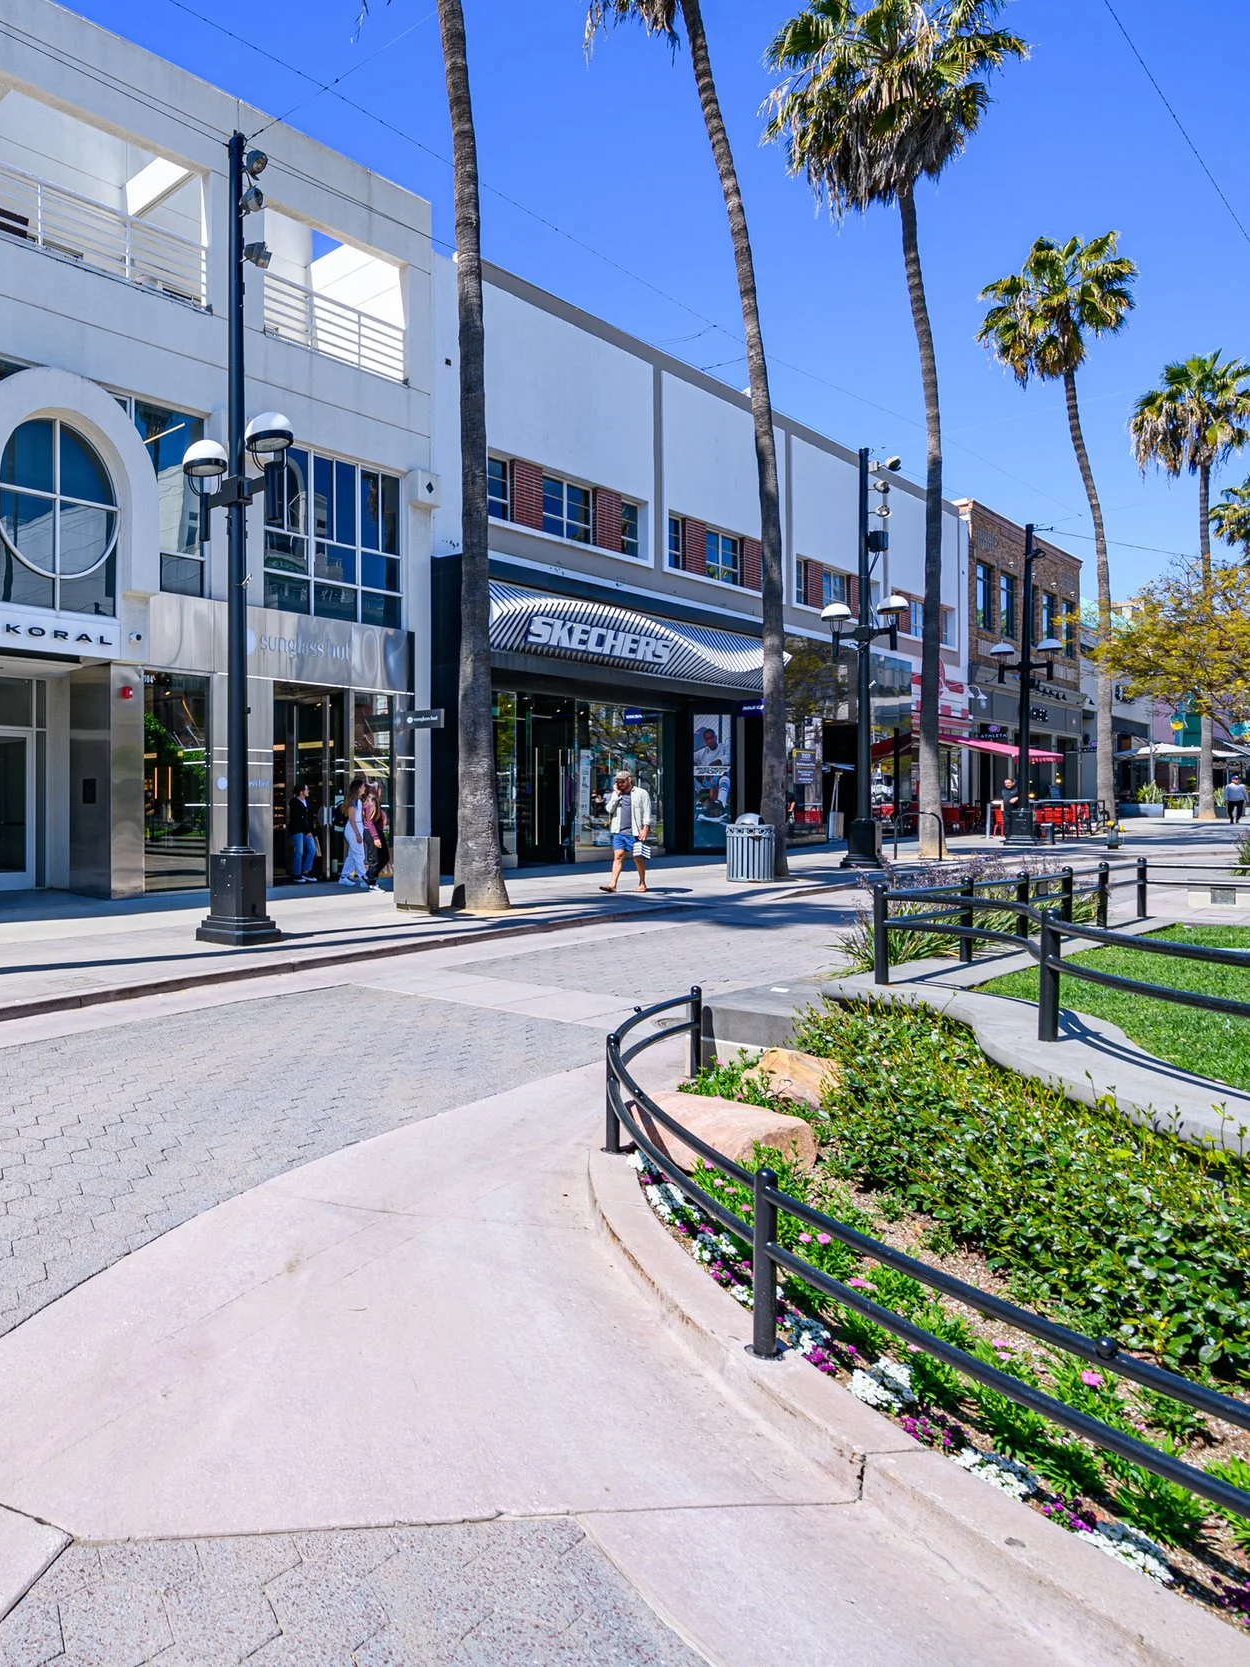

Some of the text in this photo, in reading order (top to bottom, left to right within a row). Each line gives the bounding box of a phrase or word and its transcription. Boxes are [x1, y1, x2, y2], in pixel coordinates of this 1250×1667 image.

[5, 623, 112, 646] KORAL
[259, 633, 350, 661] sunglass hut
[526, 615, 673, 664] SKECHERS
